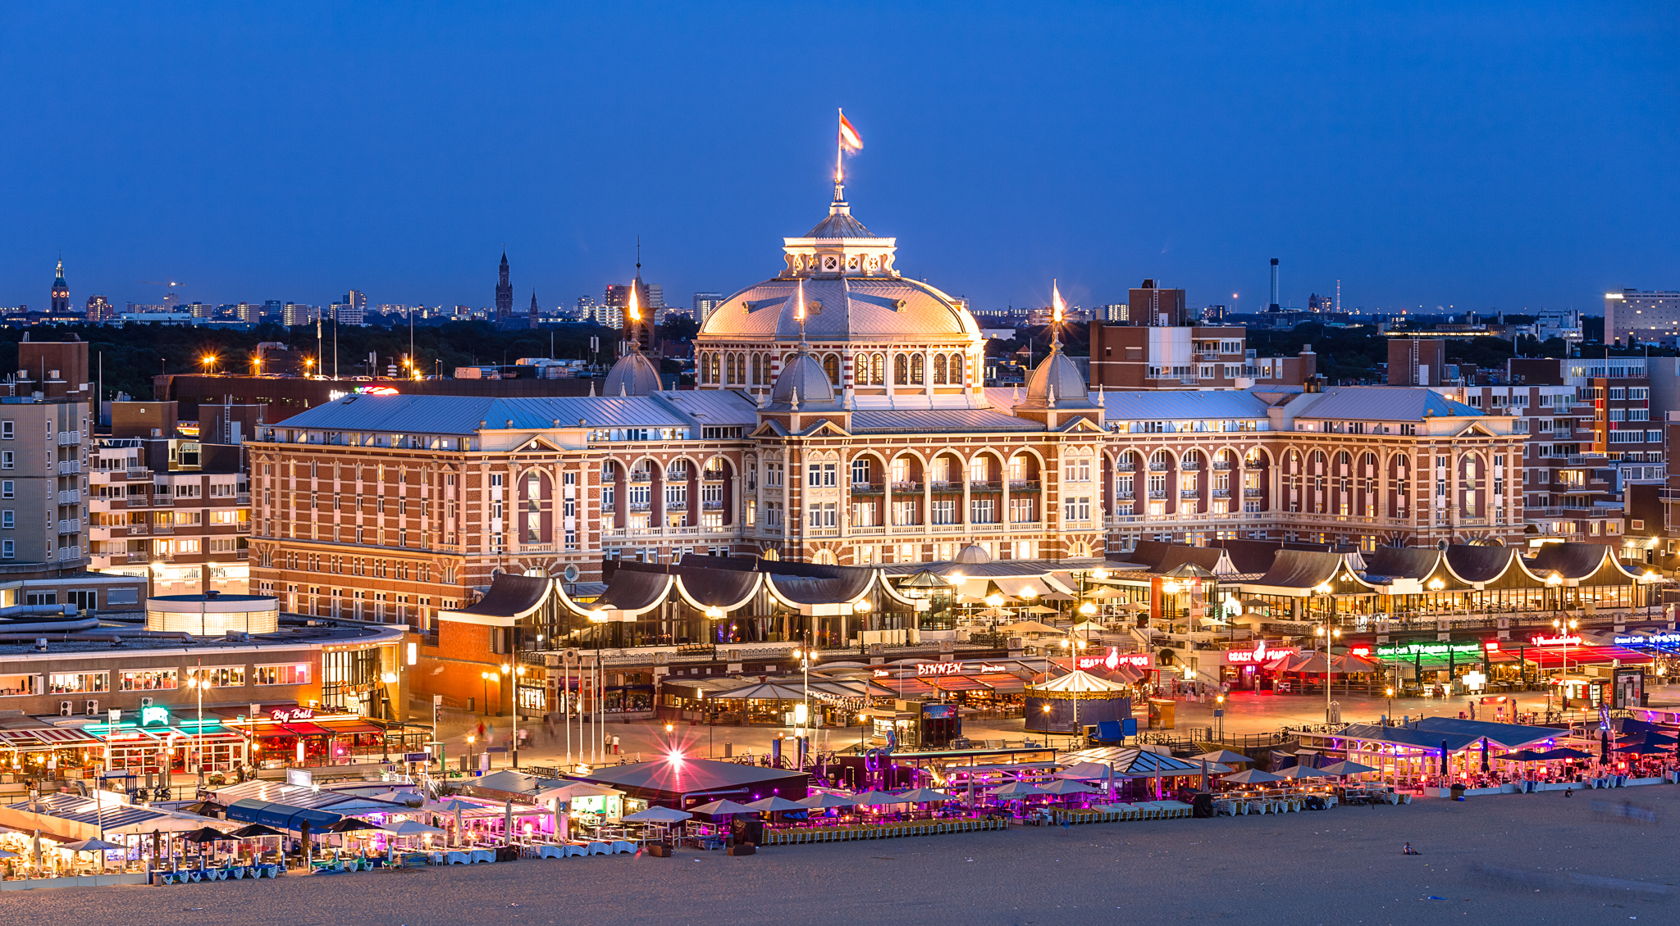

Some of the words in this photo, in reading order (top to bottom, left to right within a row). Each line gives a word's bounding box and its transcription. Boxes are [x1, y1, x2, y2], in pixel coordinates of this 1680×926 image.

[1228, 652, 1252, 661] CRAZY
[917, 662, 963, 675] BINNEN
[1080, 658, 1104, 668] CRAZY
[271, 709, 289, 723] Big
[291, 708, 314, 719] Bell
